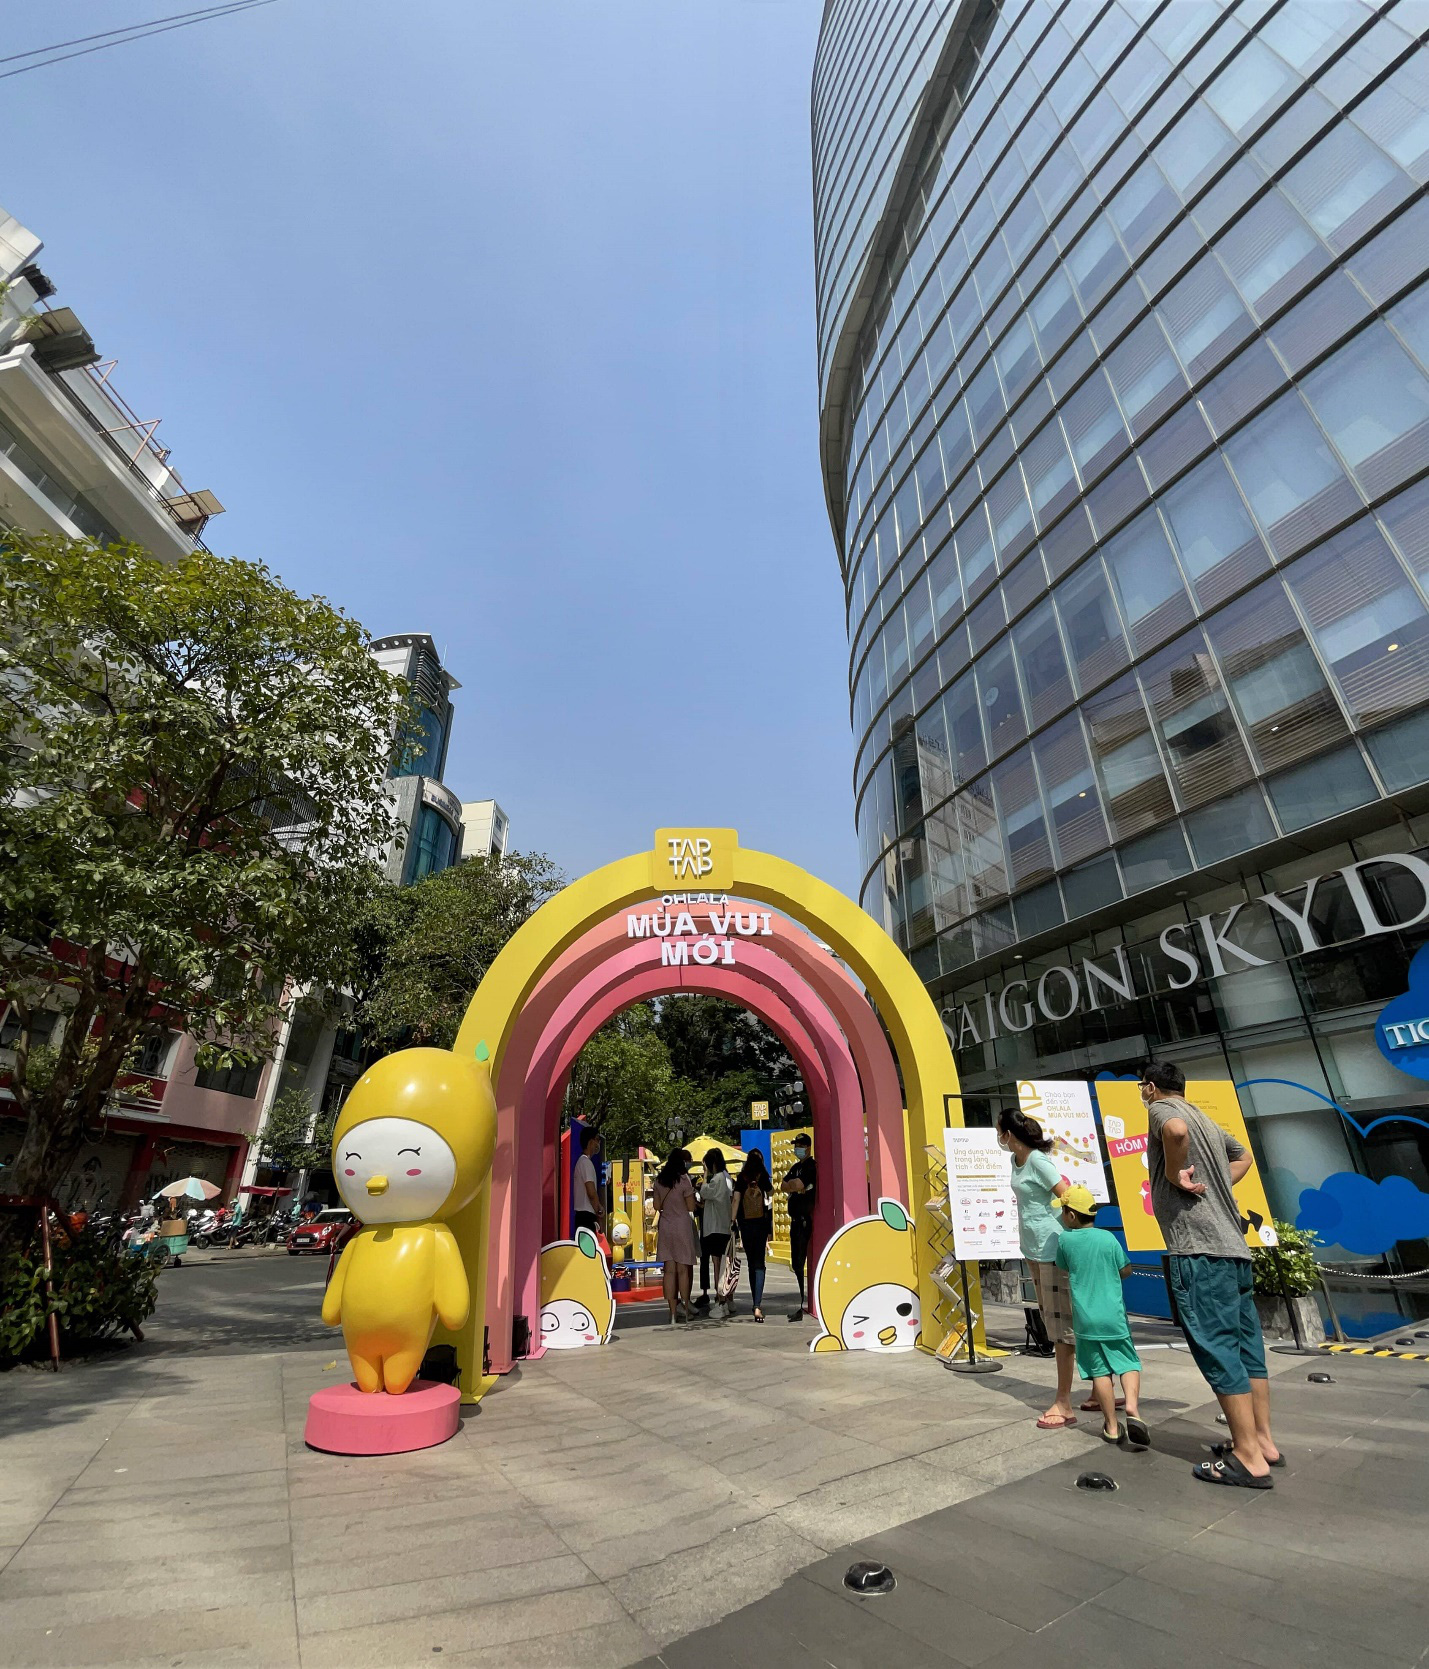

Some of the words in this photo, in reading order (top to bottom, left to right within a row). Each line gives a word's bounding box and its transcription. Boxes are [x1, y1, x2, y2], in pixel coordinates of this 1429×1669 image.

[668, 838, 712, 858] TAP
[669, 857, 713, 876] TAP
[661, 892, 730, 907] OHLALA
[627, 907, 698, 938] MÙA
[708, 911, 773, 936] VUI
[661, 933, 736, 966] MỚI
[940, 943, 1138, 1051] SAIGON
[1160, 853, 1429, 989] SKYD
[1115, 1138, 1143, 1154] HÔM
